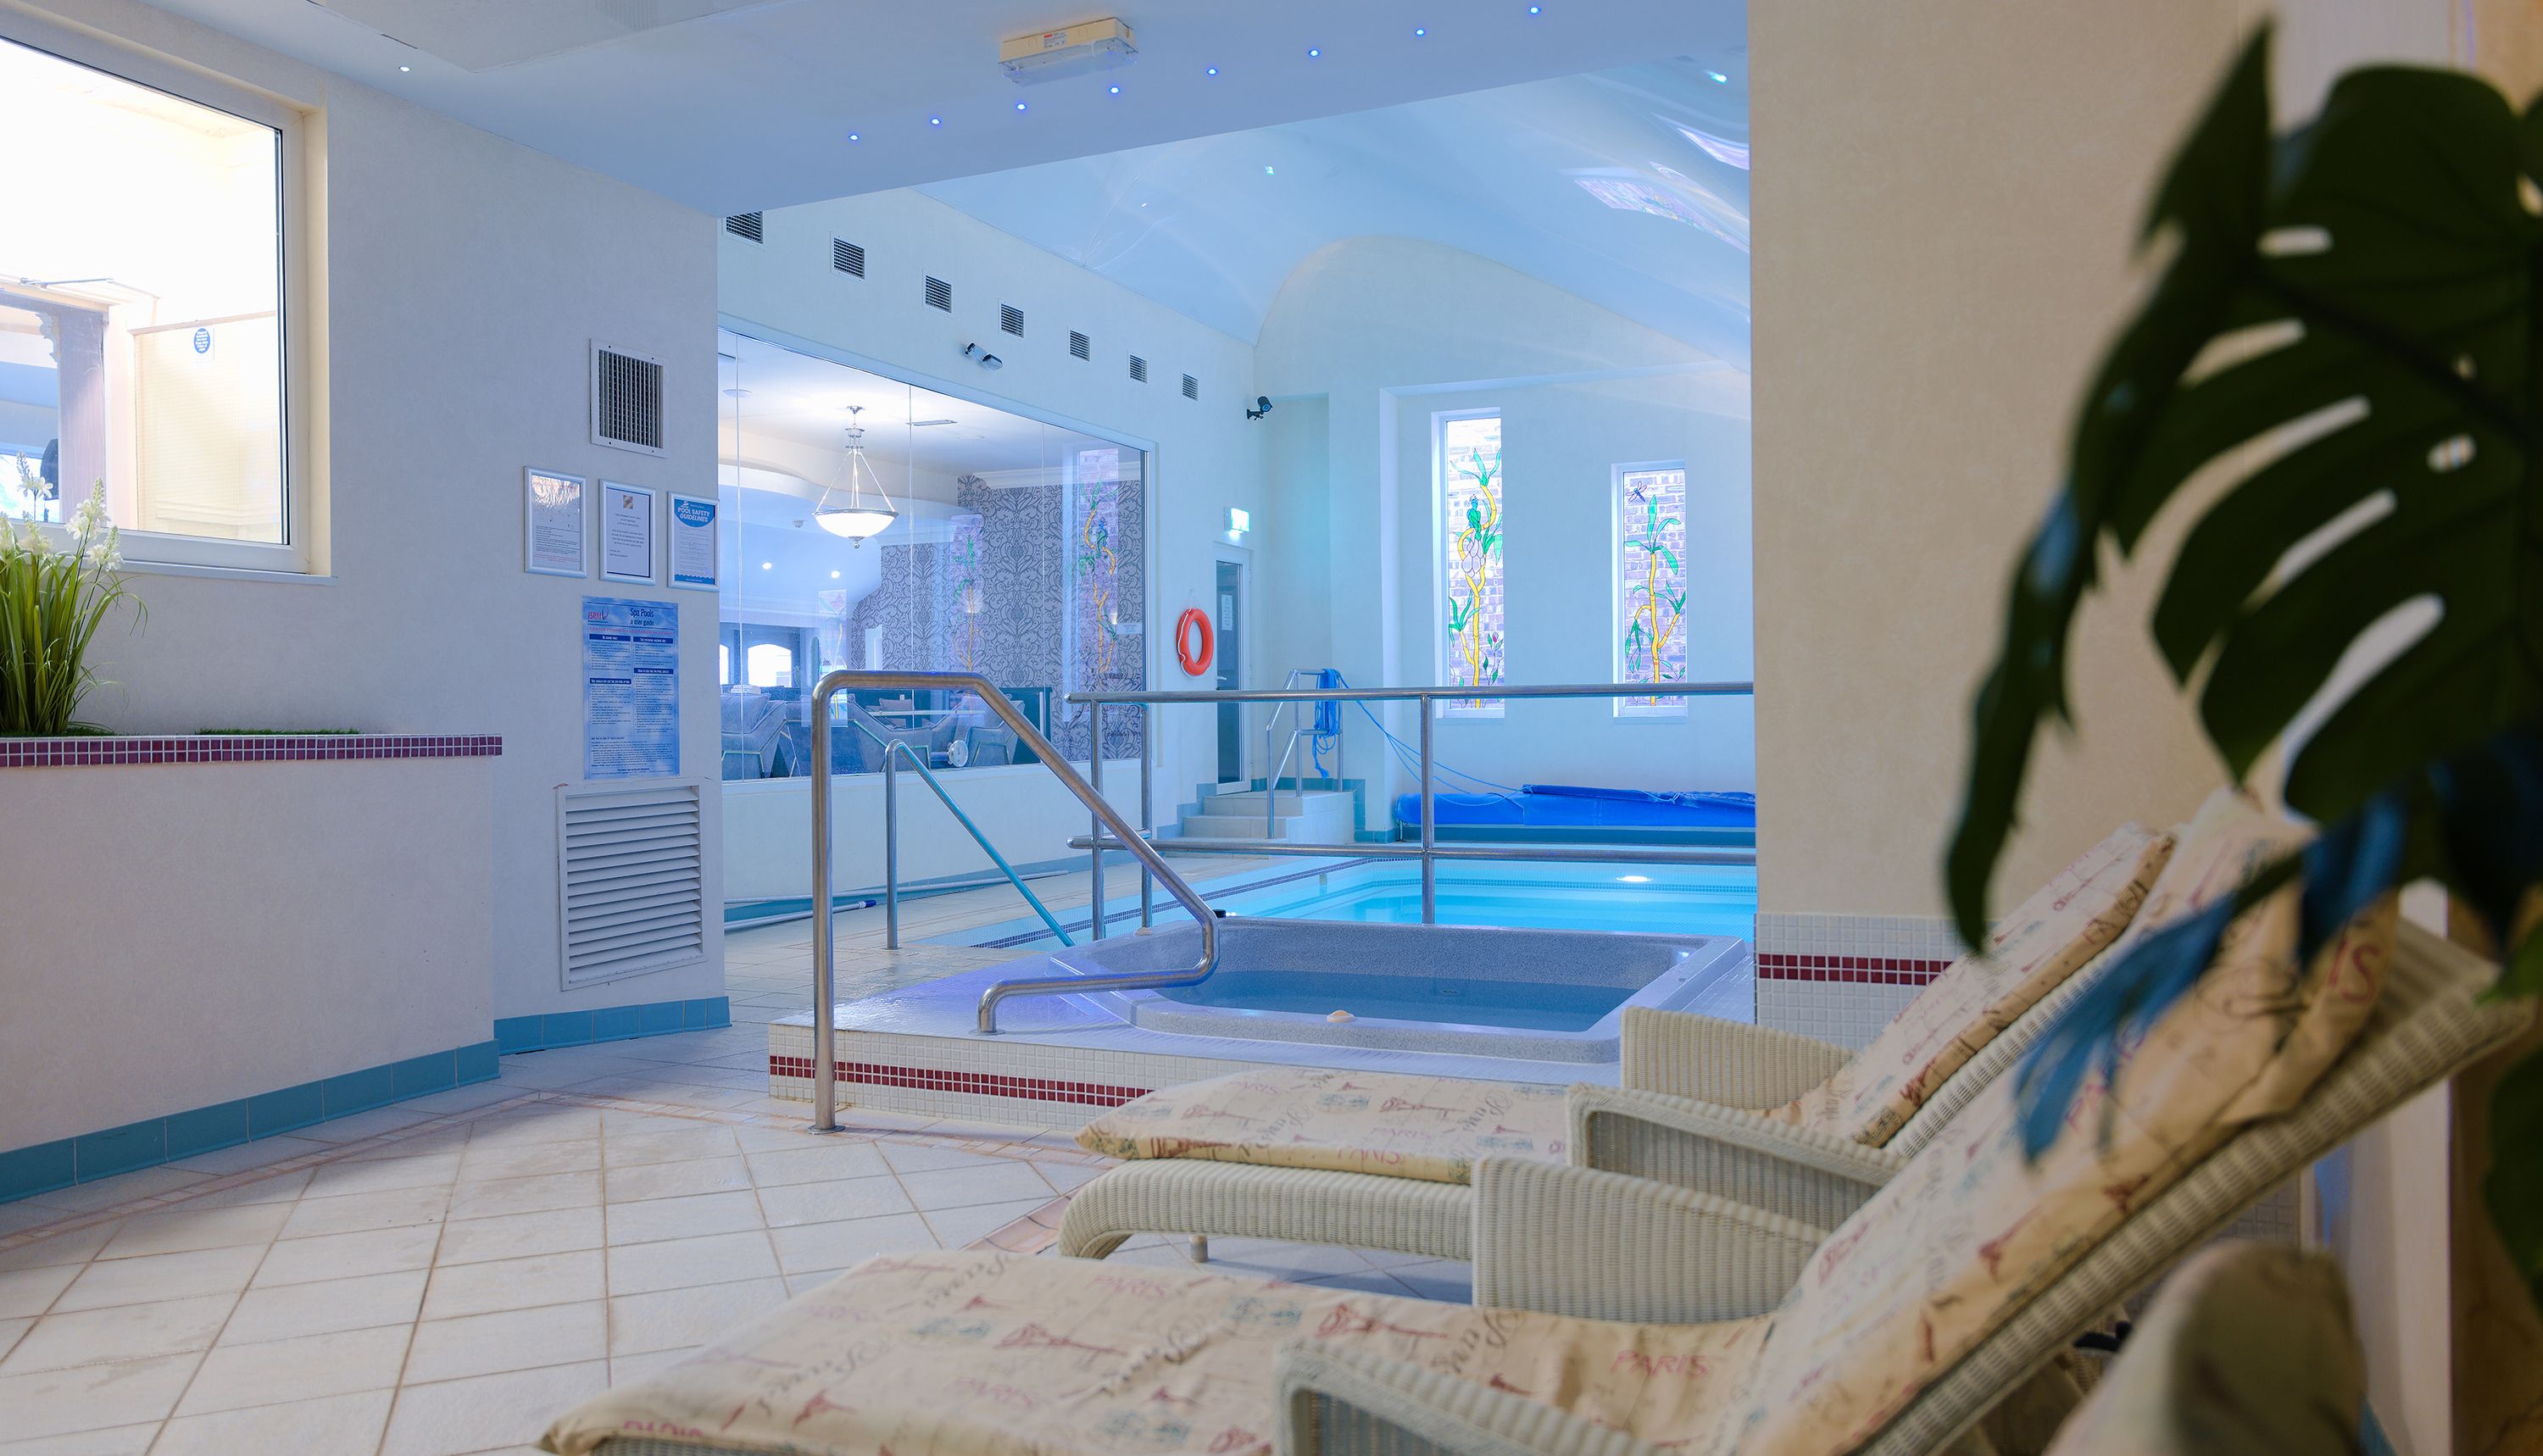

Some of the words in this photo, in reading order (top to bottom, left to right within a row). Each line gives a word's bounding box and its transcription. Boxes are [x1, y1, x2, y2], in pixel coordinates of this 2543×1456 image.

[691, 508, 710, 517] SAFETY
[680, 514, 709, 523] GUIDELINES
[630, 608, 640, 618] Spa
[641, 609, 654, 618] Pools
[1611, 1349, 1708, 1379] PARIS
